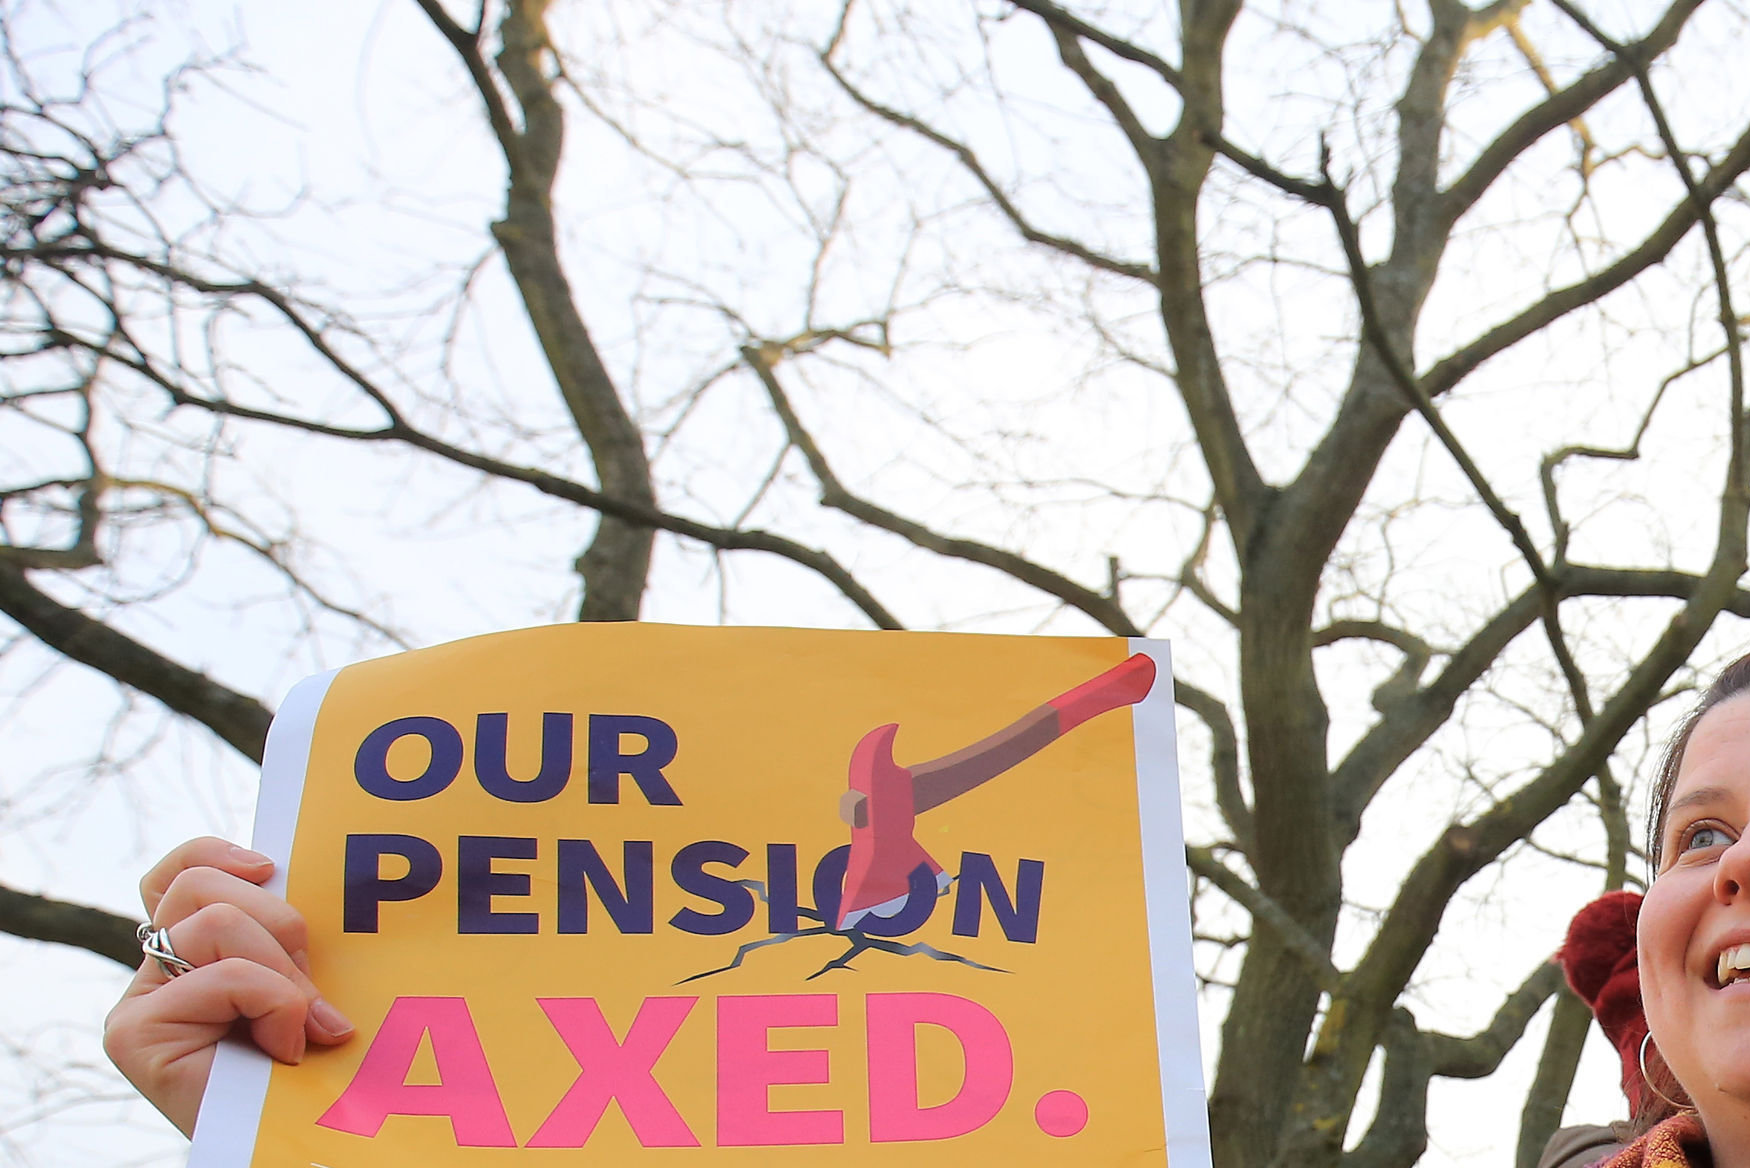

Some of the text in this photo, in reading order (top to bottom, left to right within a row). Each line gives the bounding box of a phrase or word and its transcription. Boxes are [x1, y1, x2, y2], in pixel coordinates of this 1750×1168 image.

[353, 711, 683, 806] OUR
[342, 832, 1045, 945] PENSION
[315, 991, 1089, 1149] AXED.
